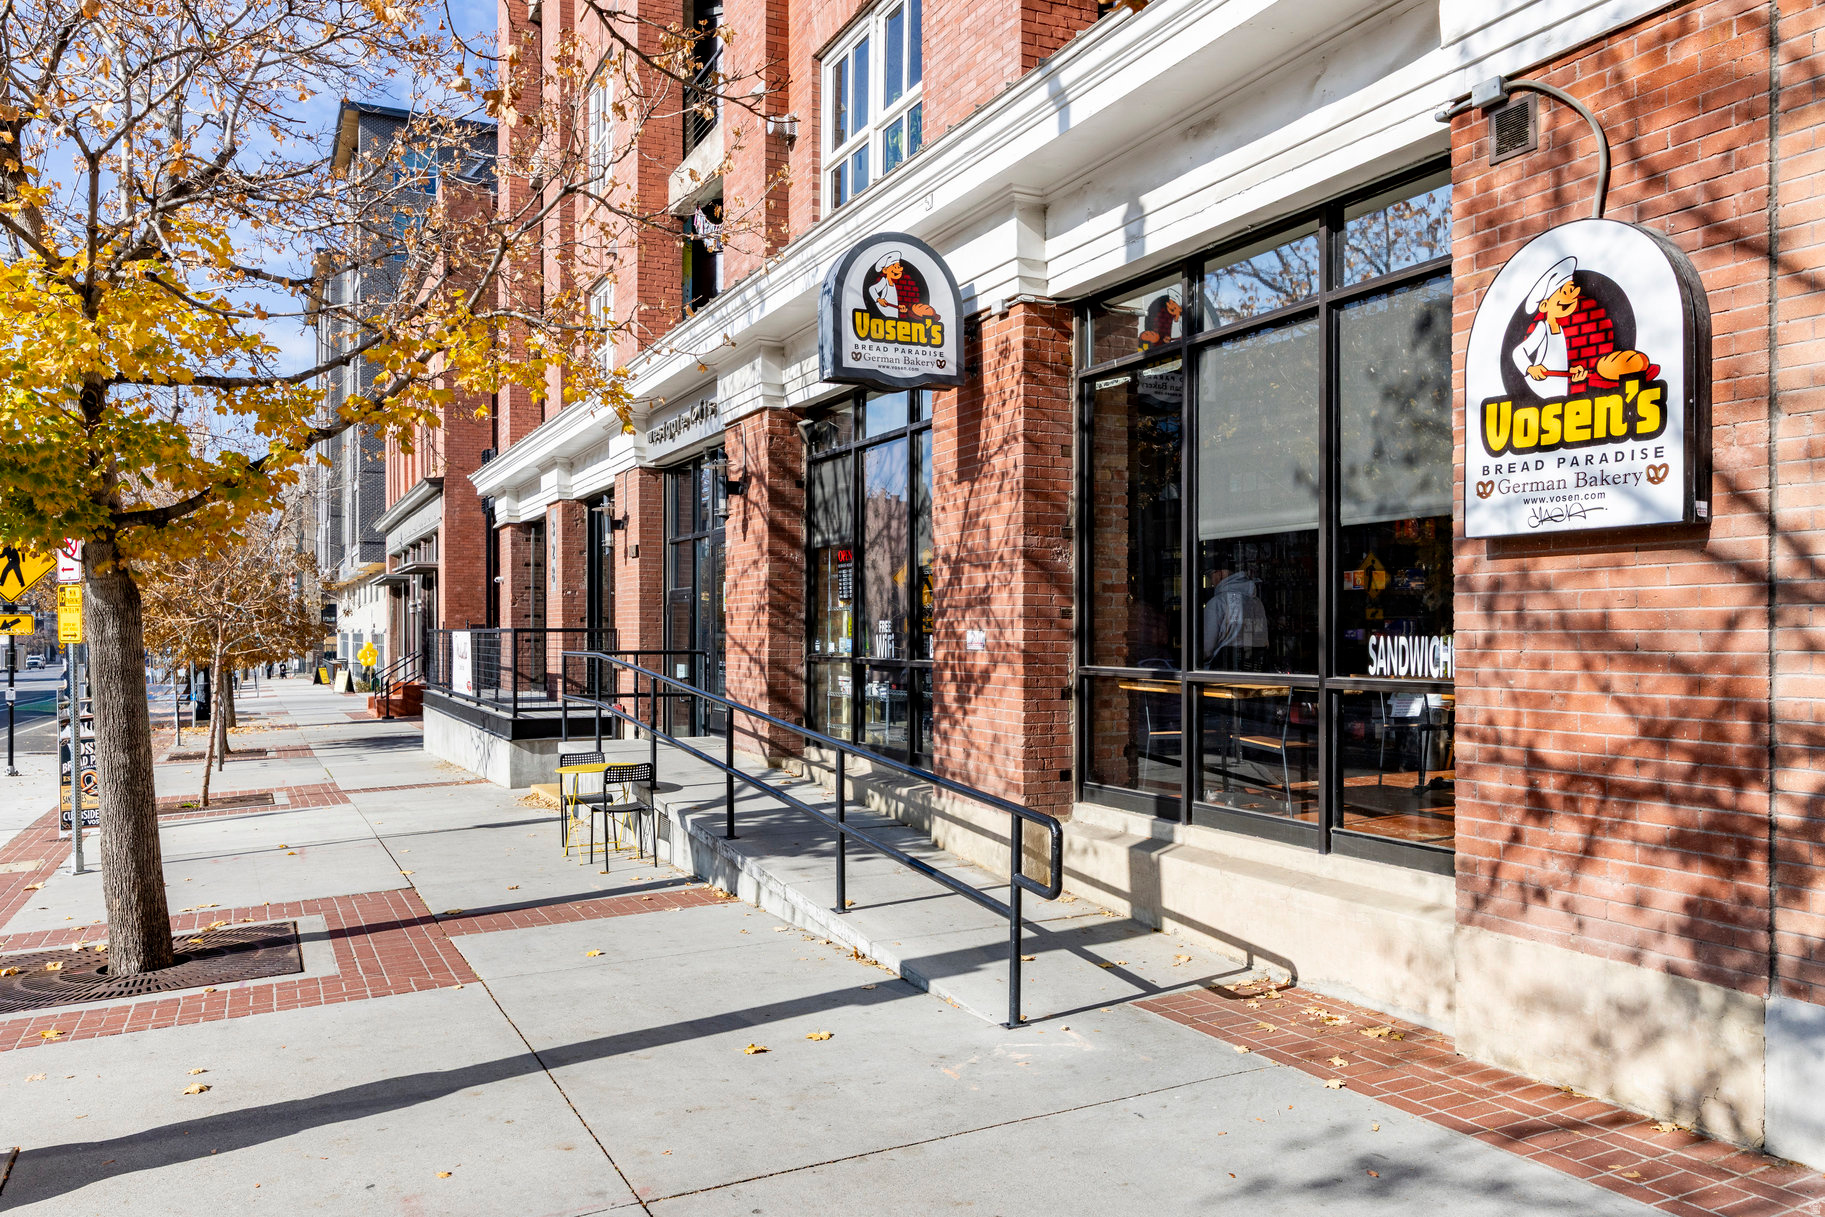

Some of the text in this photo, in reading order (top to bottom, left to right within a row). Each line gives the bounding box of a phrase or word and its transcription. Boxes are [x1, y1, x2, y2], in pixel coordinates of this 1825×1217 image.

[854, 311, 943, 346] Vosen's
[854, 343, 945, 358] BREAD PARADISE
[863, 353, 936, 369] German Bakery
[877, 364, 920, 372] www.vosen.com
[1485, 379, 1661, 452] Vosen's
[1482, 446, 1664, 476] BREAD PARADISE
[1498, 469, 1643, 496] German Bakery
[1523, 491, 1606, 505] www.vosen.com
[838, 549, 853, 562] OPEN
[878, 620, 892, 633] FREE
[875, 633, 895, 658] WiFi
[1368, 634, 1455, 679] SANDWICH
